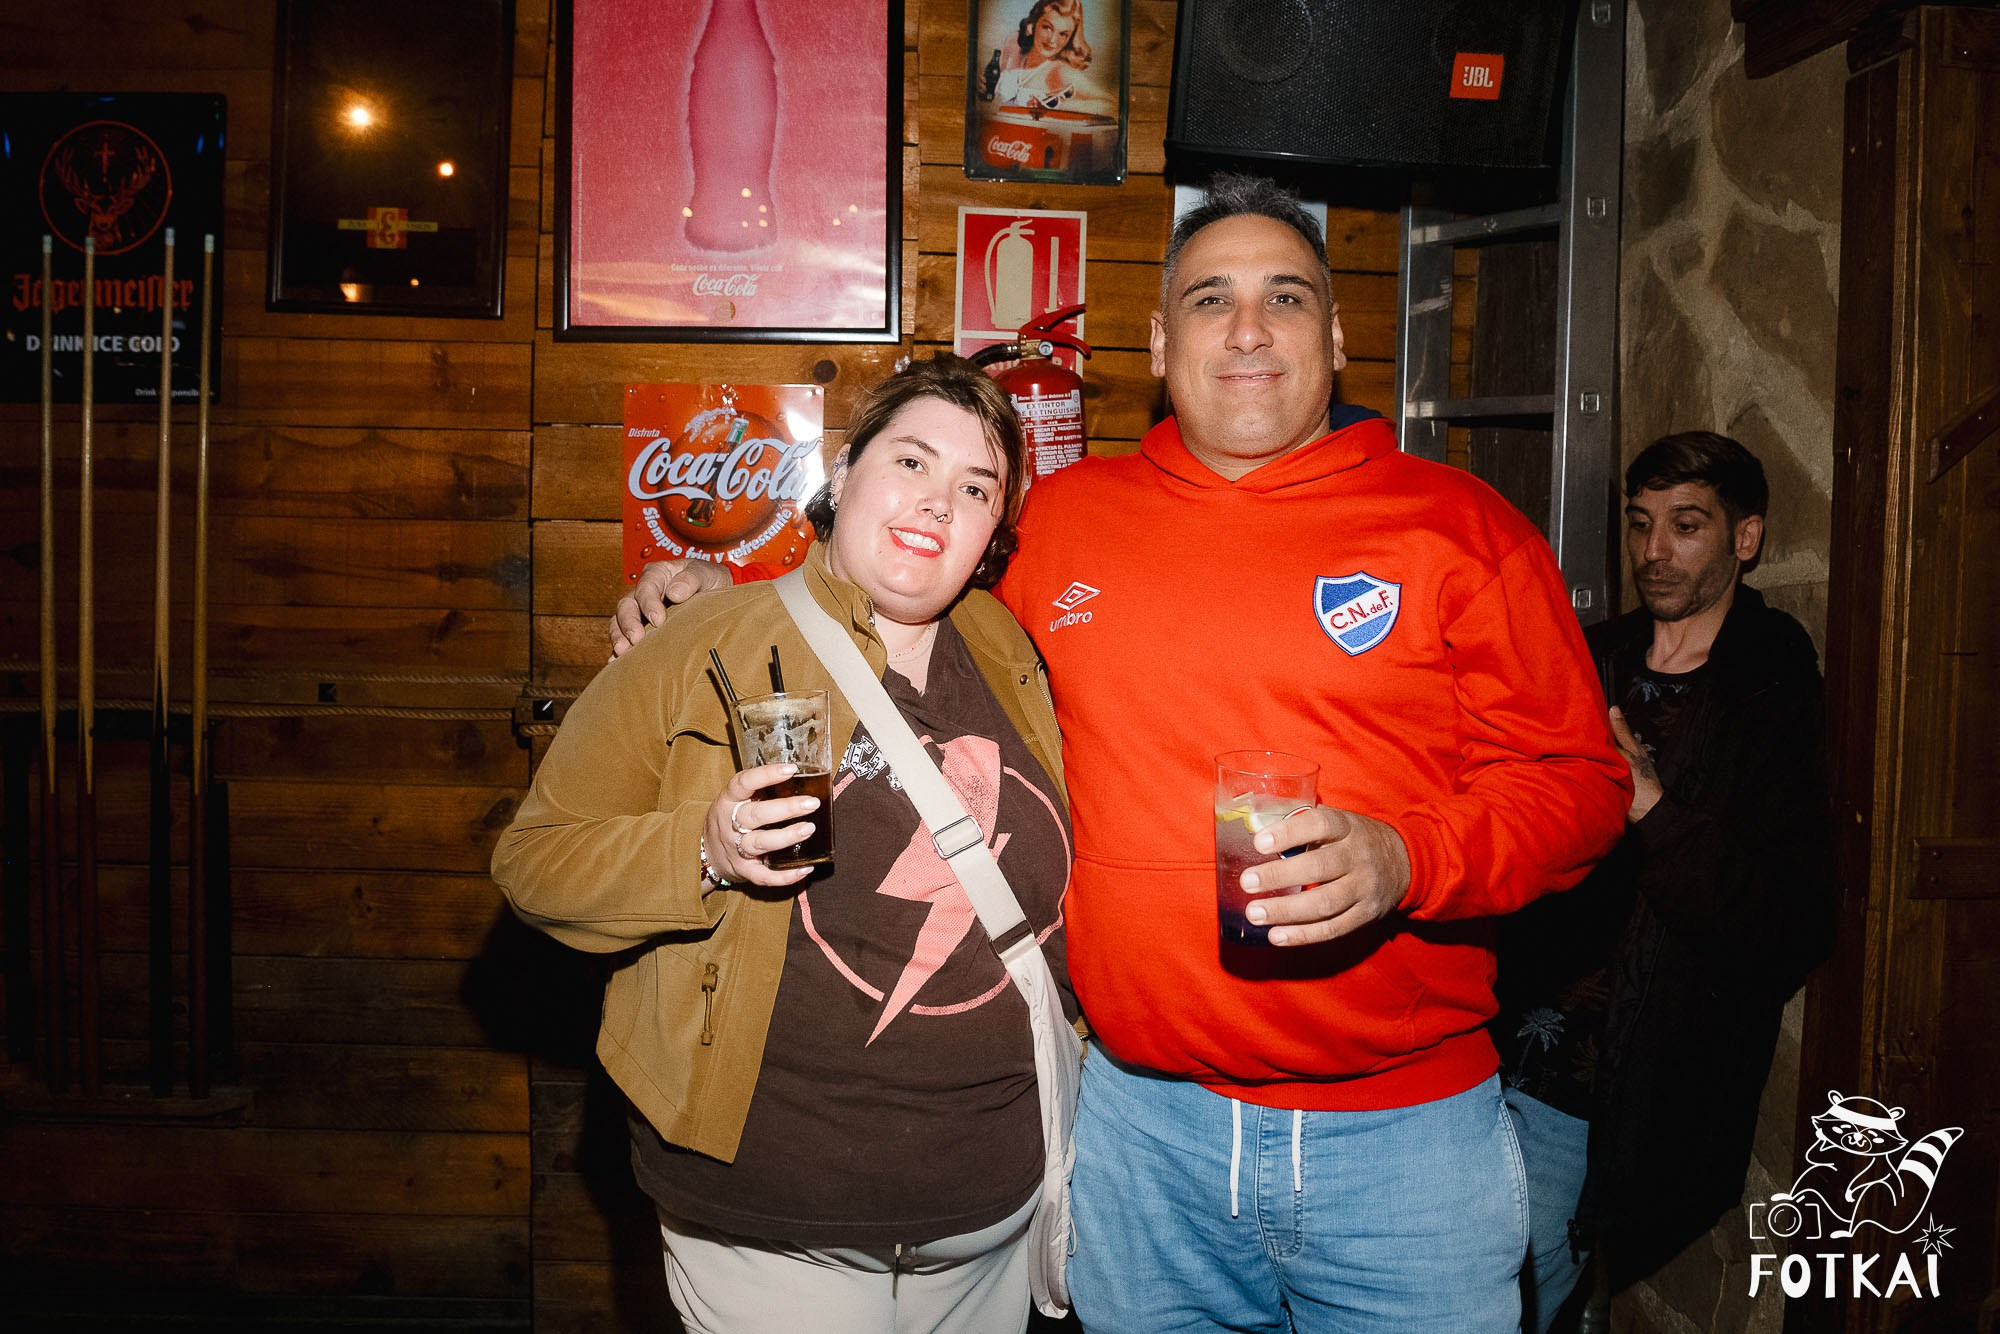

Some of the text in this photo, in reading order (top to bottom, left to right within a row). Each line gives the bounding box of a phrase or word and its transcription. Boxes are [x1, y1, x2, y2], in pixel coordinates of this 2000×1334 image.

[1463, 66, 1494, 88] JBL
[988, 135, 1032, 163] Coca-Cola
[692, 273, 760, 297] Coca-Cola
[26, 335, 86, 352] DINK
[93, 335, 123, 352] ICE
[1026, 401, 1066, 410] EXTINTOR
[628, 427, 660, 438] Disfruta
[628, 437, 824, 501] Coca-Cola
[642, 506, 683, 557] Siempre
[1049, 611, 1093, 632] umbro
